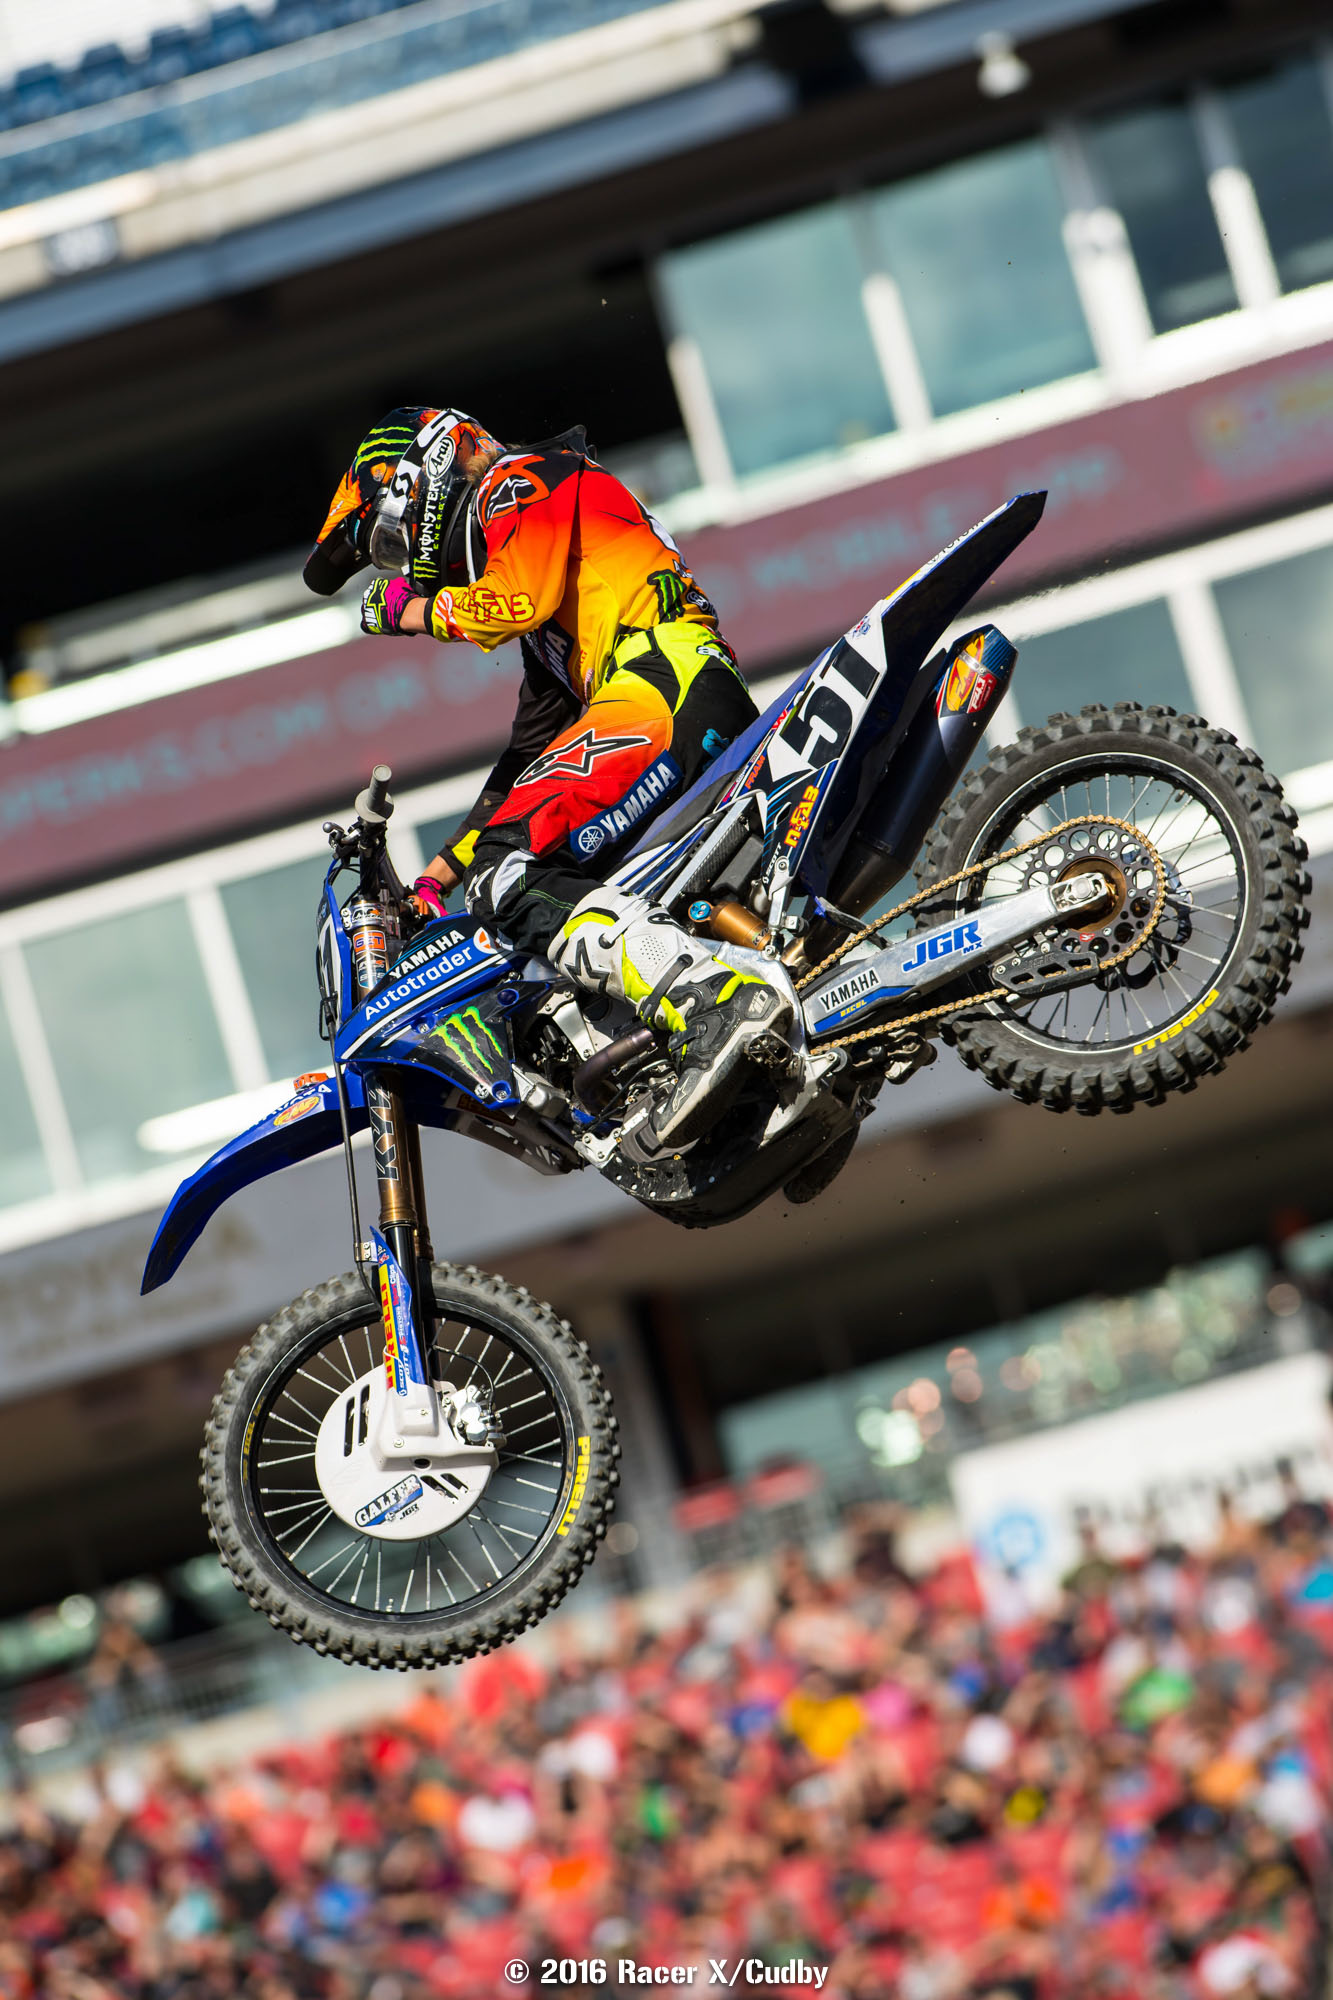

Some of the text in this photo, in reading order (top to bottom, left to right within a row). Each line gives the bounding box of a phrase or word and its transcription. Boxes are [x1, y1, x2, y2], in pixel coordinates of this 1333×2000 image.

[430, 441, 450, 475] Arai
[419, 478, 443, 561] MONSTER
[433, 495, 447, 550] ENERGY
[779, 636, 881, 771] 51
[744, 754, 766, 789] FRAM
[600, 762, 676, 838] YAMAHA
[389, 929, 466, 980] YAMAHA
[902, 919, 982, 973] JGR
[962, 941, 984, 955] MX
[364, 945, 474, 1021] Autotrader
[820, 970, 880, 1011] YAMAHA
[1133, 988, 1220, 1056] PIRELLI
[556, 1435, 591, 1537] PIRELLI
